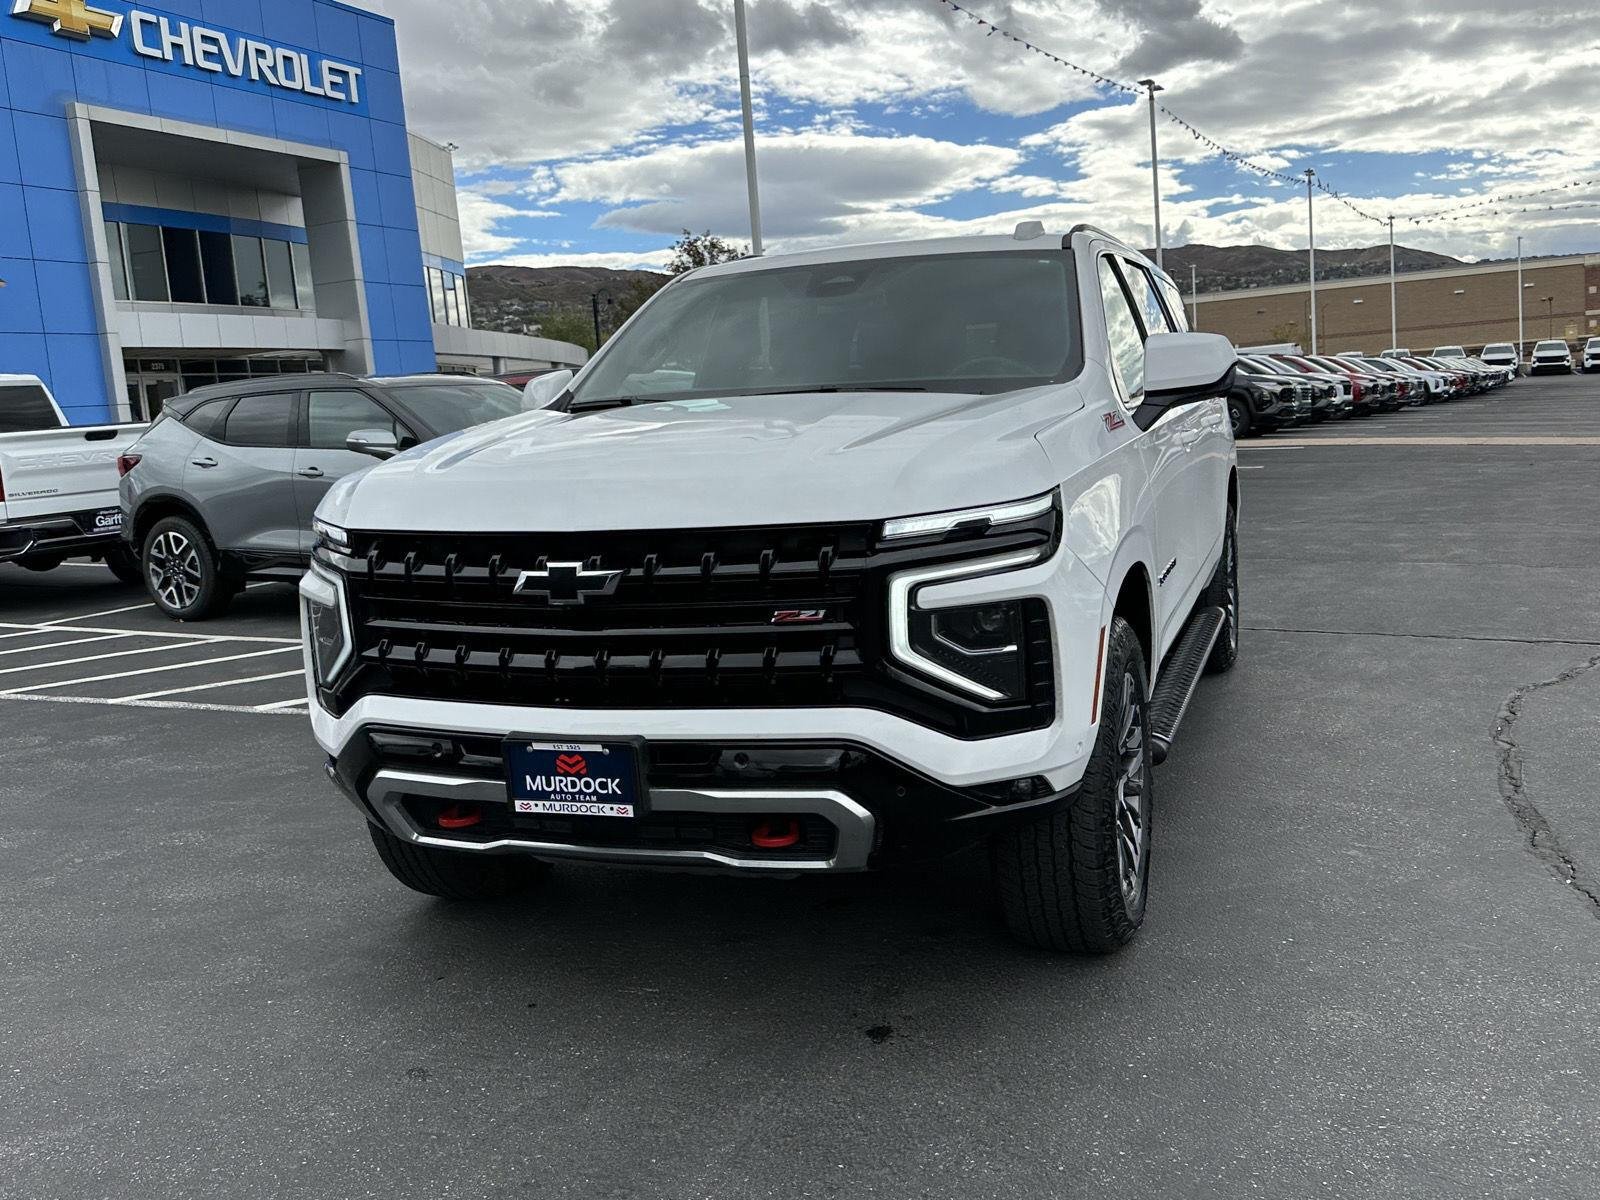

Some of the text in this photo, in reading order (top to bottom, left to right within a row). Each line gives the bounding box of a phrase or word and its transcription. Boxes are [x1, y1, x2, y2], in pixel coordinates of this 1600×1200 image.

[130, 9, 362, 104] CHEVROLET
[8, 488, 59, 497] SILVERADO
[95, 513, 122, 527] Garff
[770, 609, 826, 623] Z71
[525, 775, 622, 795] MURDOCK
[550, 793, 597, 802] AUTO TEAM
[542, 802, 607, 815] MURDOCK
